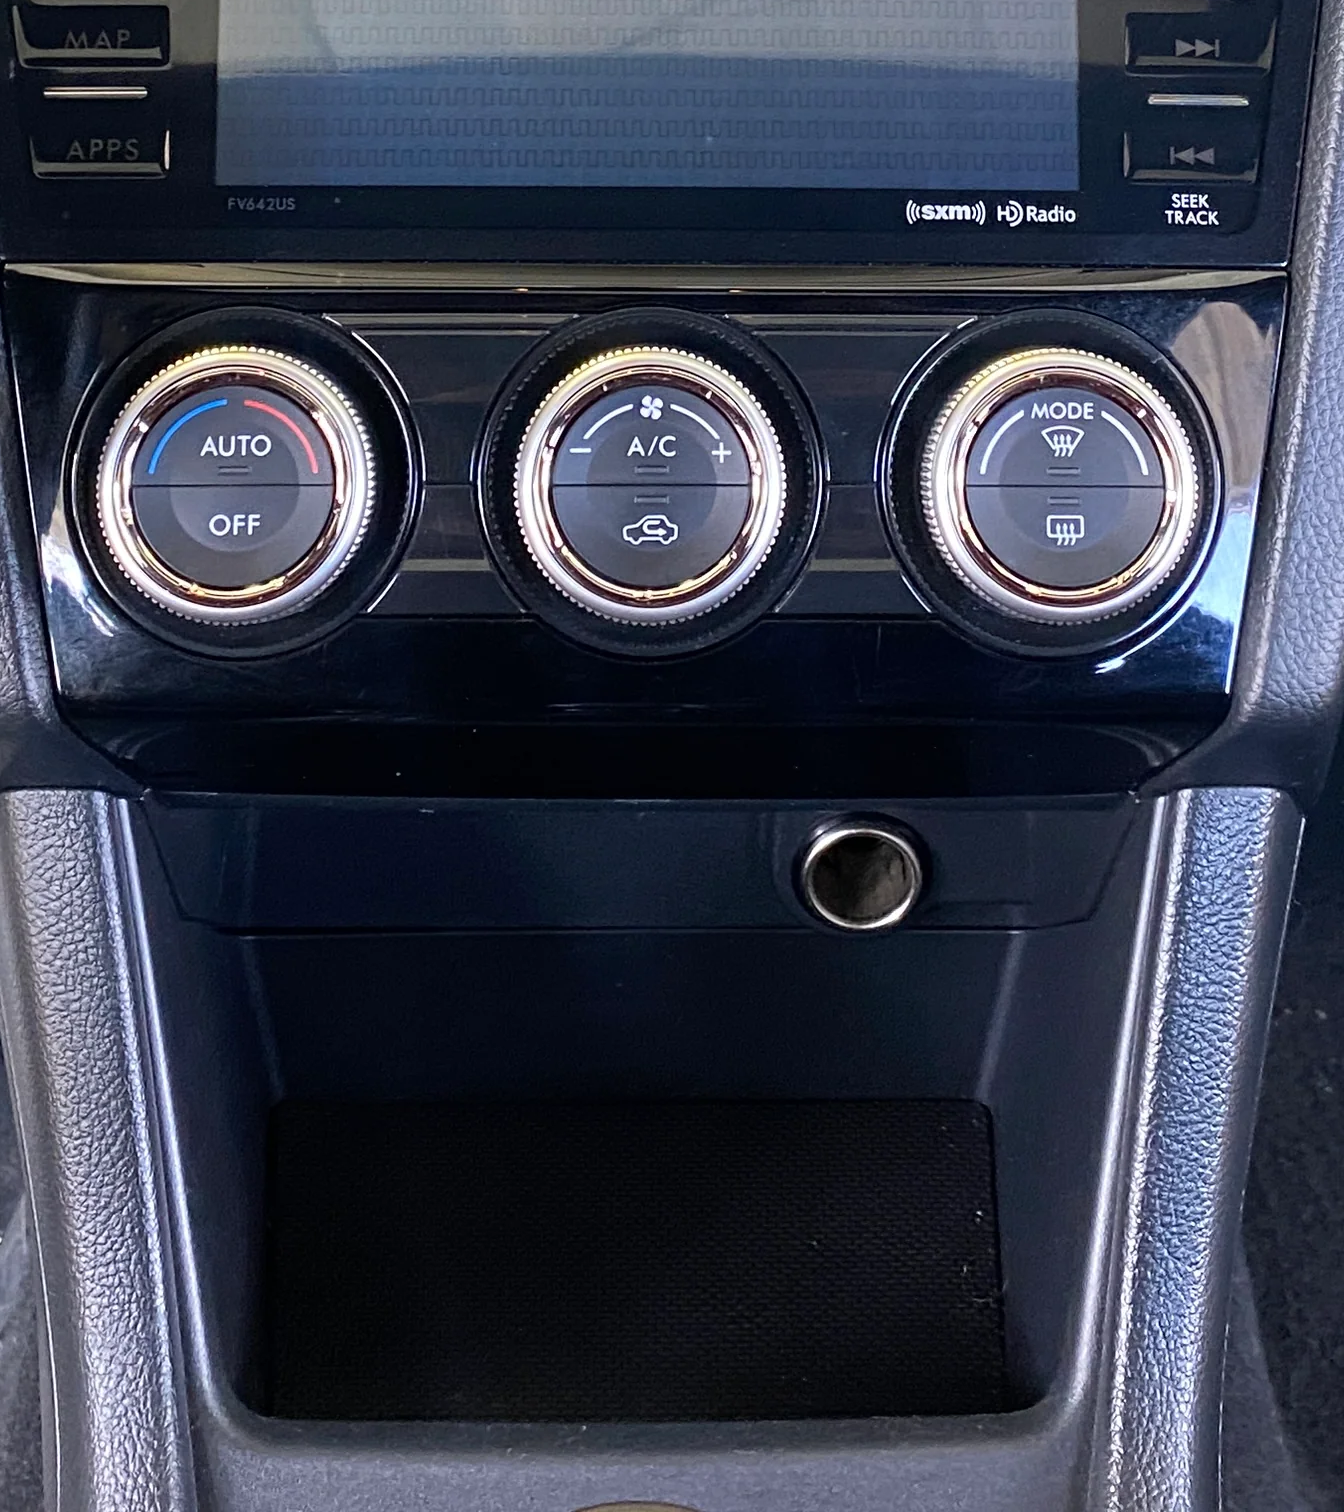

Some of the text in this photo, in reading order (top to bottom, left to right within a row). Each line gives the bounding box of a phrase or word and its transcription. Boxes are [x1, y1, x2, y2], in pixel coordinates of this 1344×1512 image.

[64, 29, 131, 50] MAP
[66, 138, 140, 161] APPS
[227, 197, 297, 212] FV642US
[1171, 193, 1210, 209] SEEK
[1026, 204, 1077, 224] Radio
[1164, 209, 1220, 226] TRACK
[1030, 402, 1094, 420] MODE
[200, 434, 272, 457] AUTO
[627, 435, 677, 457] A/C
[208, 514, 261, 536] OFF
